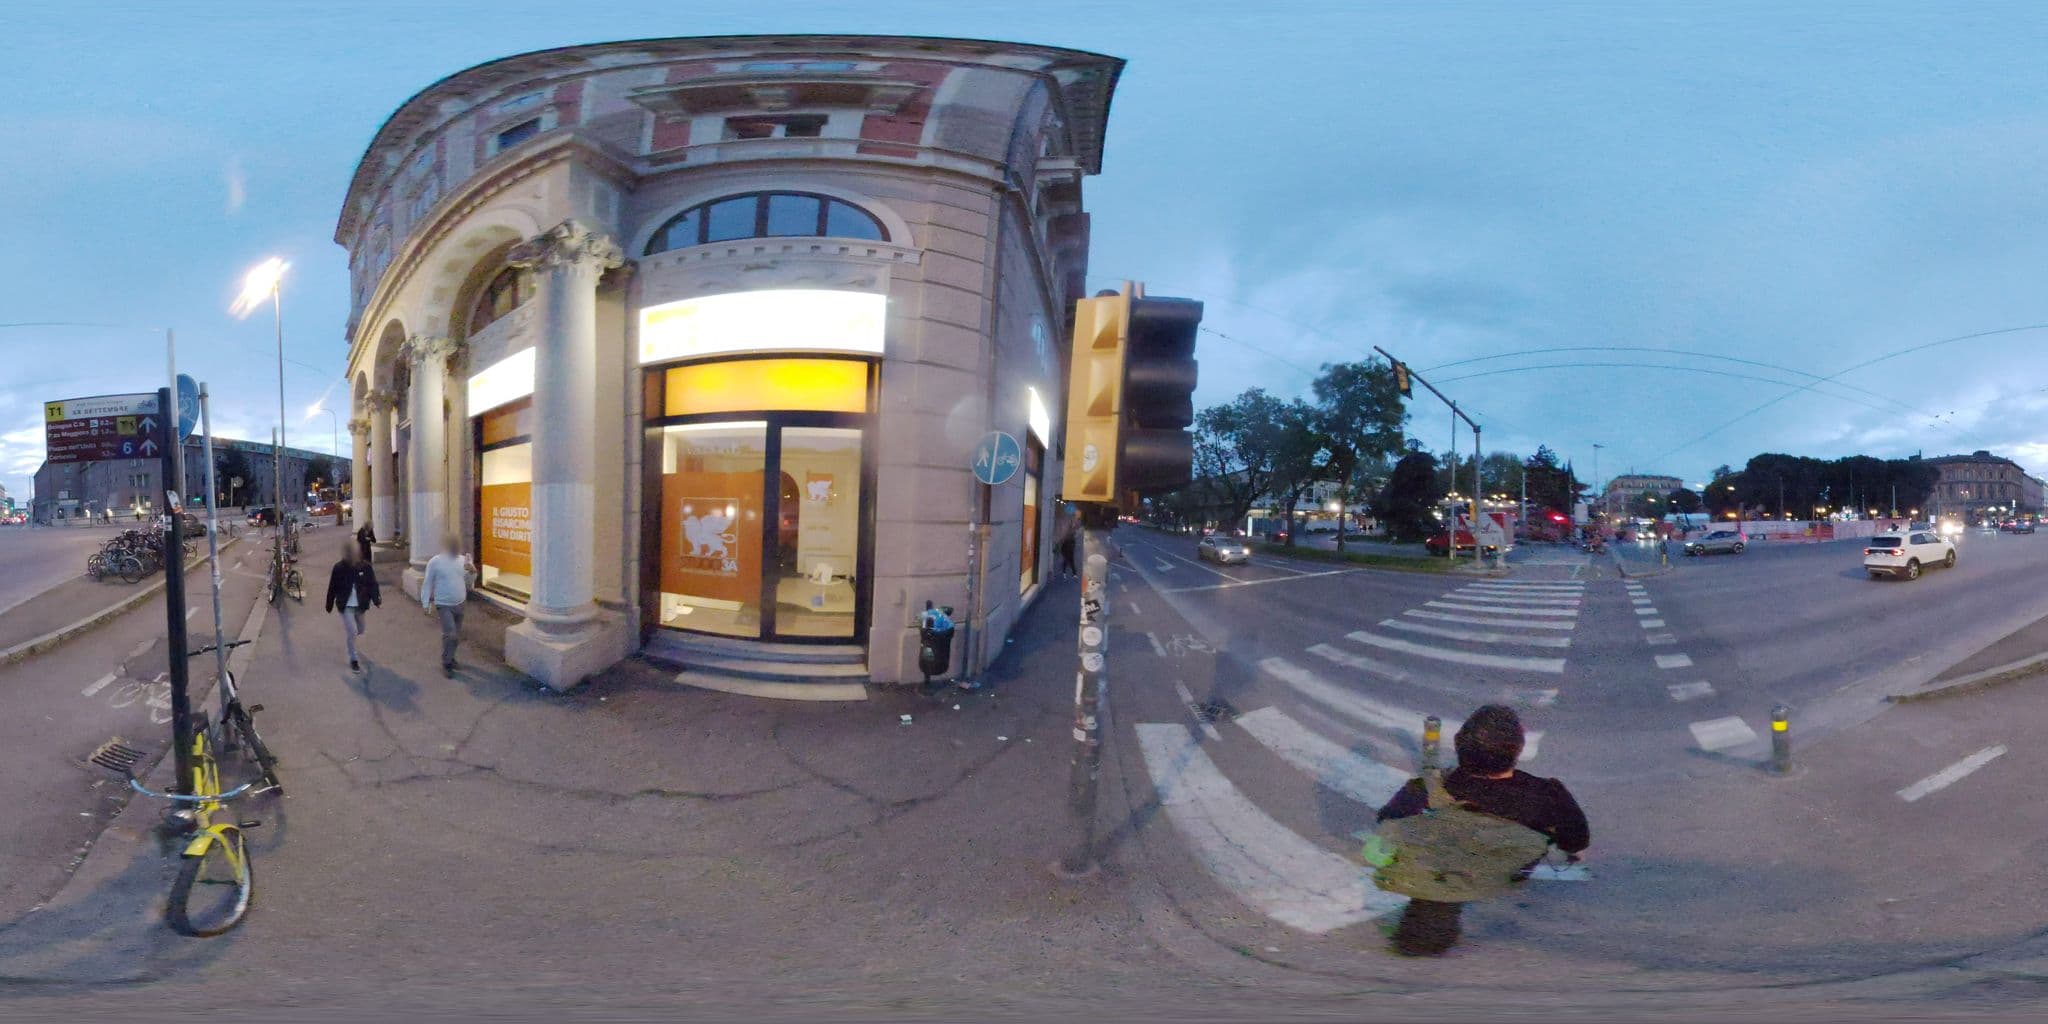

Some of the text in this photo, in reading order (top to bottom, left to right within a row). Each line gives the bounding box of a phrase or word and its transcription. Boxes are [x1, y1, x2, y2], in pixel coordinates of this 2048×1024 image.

[48, 407, 62, 417] T1
[84, 405, 129, 414] SETTEMBRE
[123, 441, 132, 454] 6
[493, 507, 528, 518] IL GIUSTO
